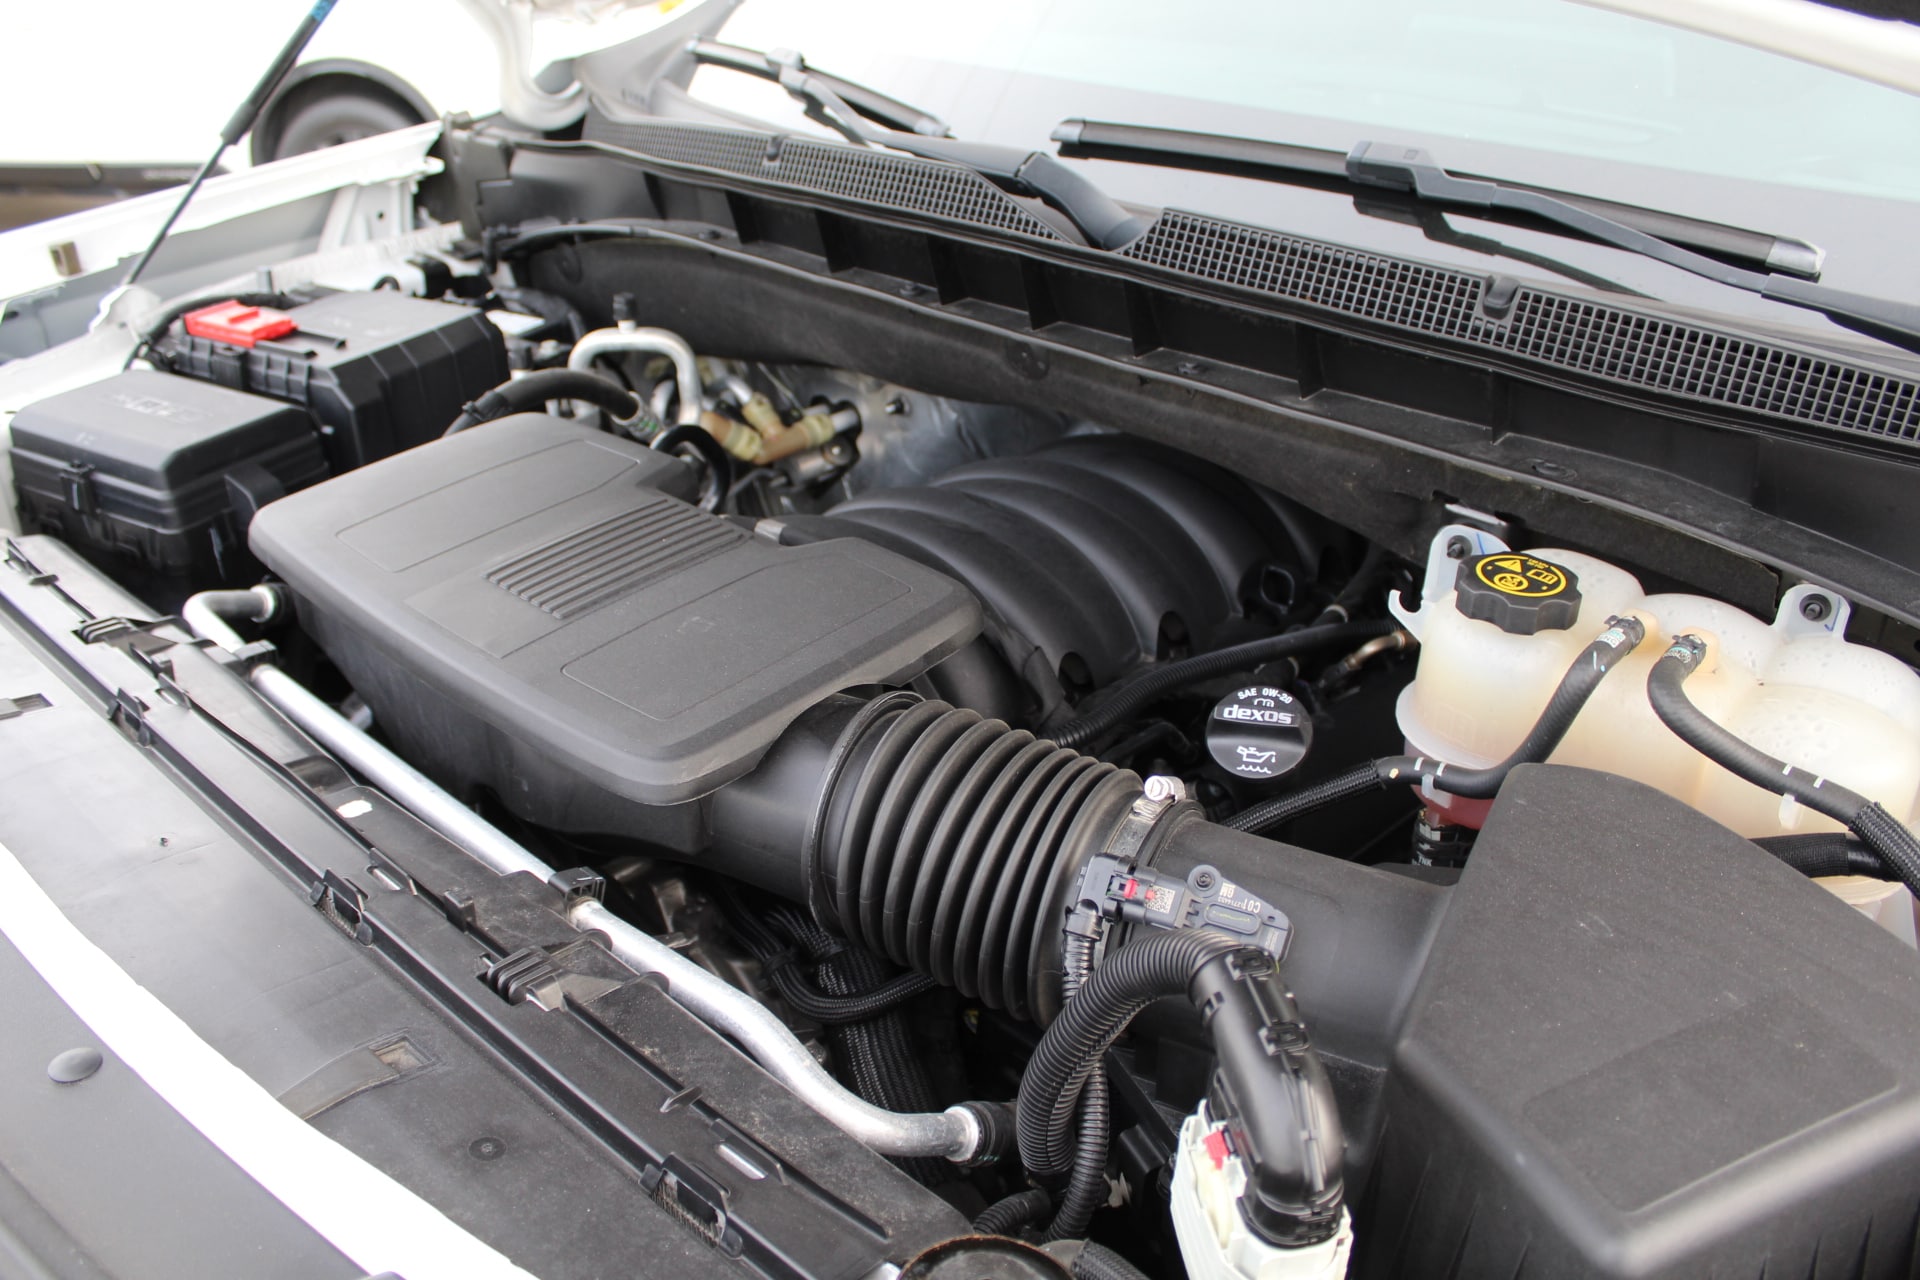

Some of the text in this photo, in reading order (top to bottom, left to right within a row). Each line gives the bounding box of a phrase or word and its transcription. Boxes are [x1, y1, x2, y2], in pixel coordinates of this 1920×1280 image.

[1237, 688, 1293, 704] SAE 0W-20
[1223, 704, 1295, 725] dexos
